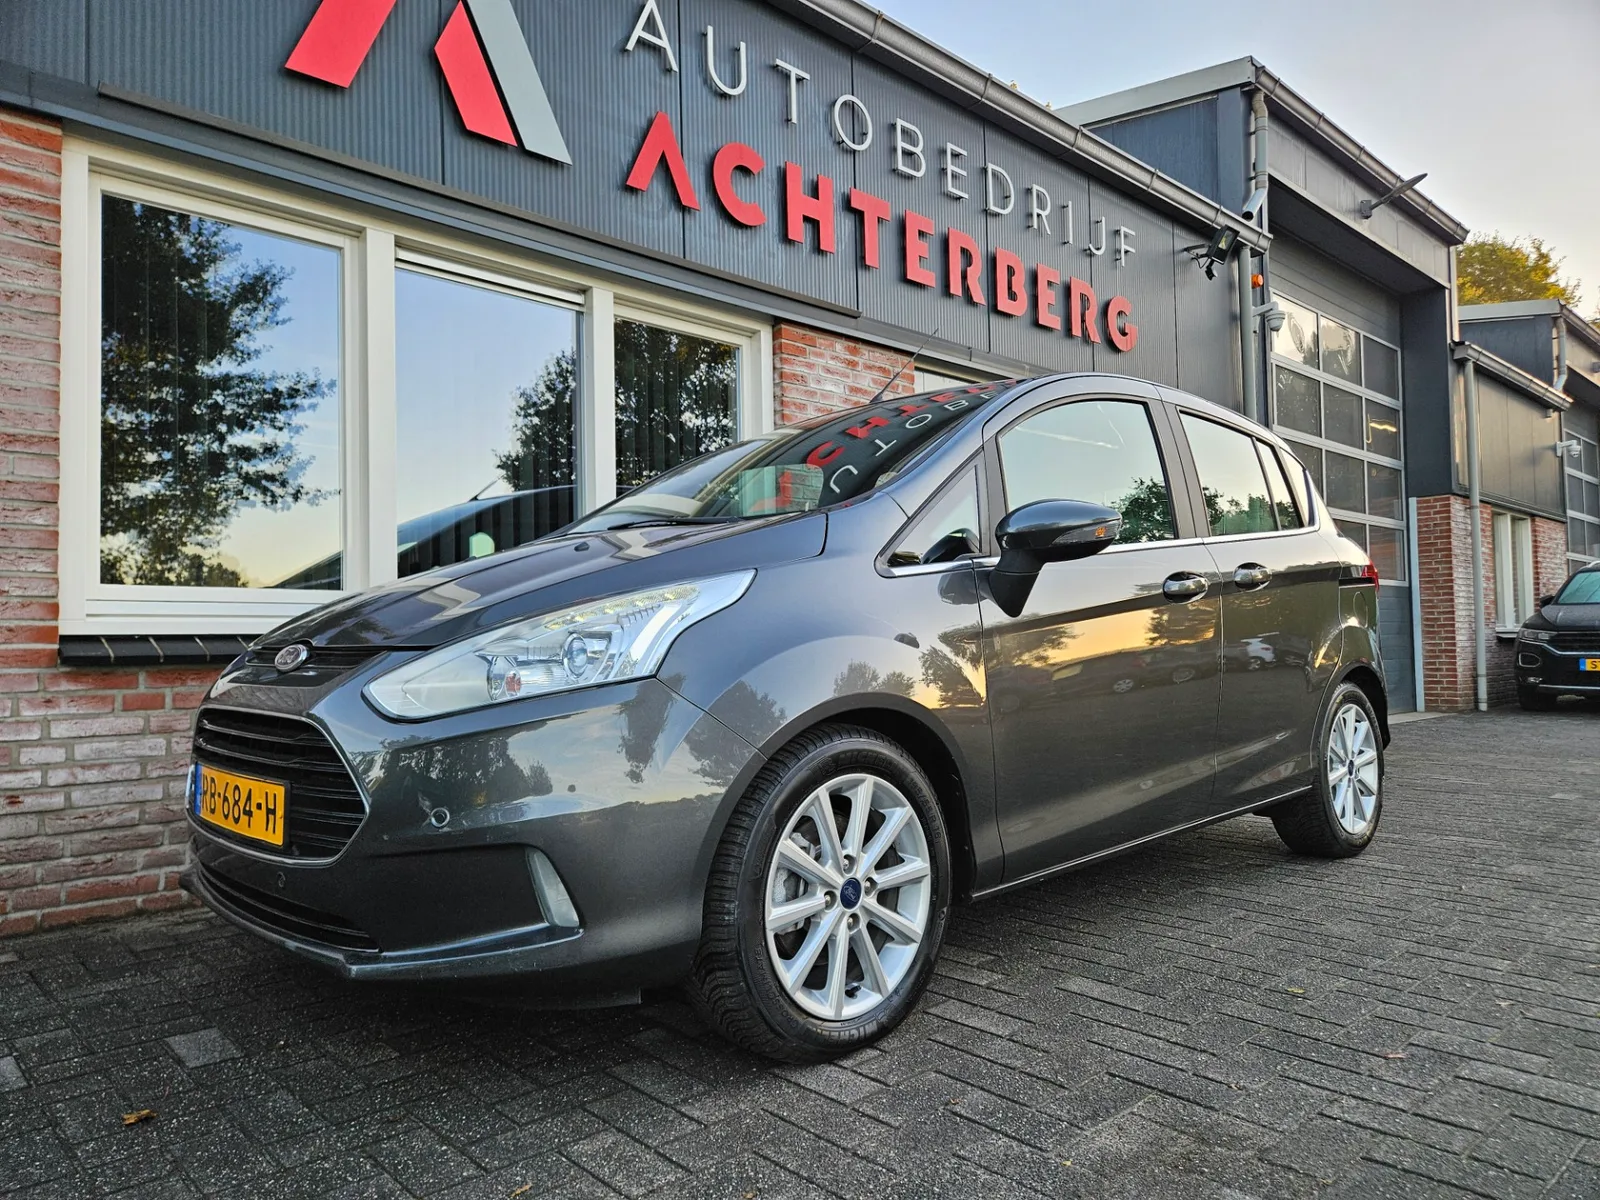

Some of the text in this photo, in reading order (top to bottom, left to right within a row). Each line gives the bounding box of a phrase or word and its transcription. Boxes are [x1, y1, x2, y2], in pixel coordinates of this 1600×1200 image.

[625, 0, 1136, 268] AUTOBEDRIJF
[626, 110, 1139, 353] ACHTERBERG
[202, 773, 277, 834] RB-684-H
